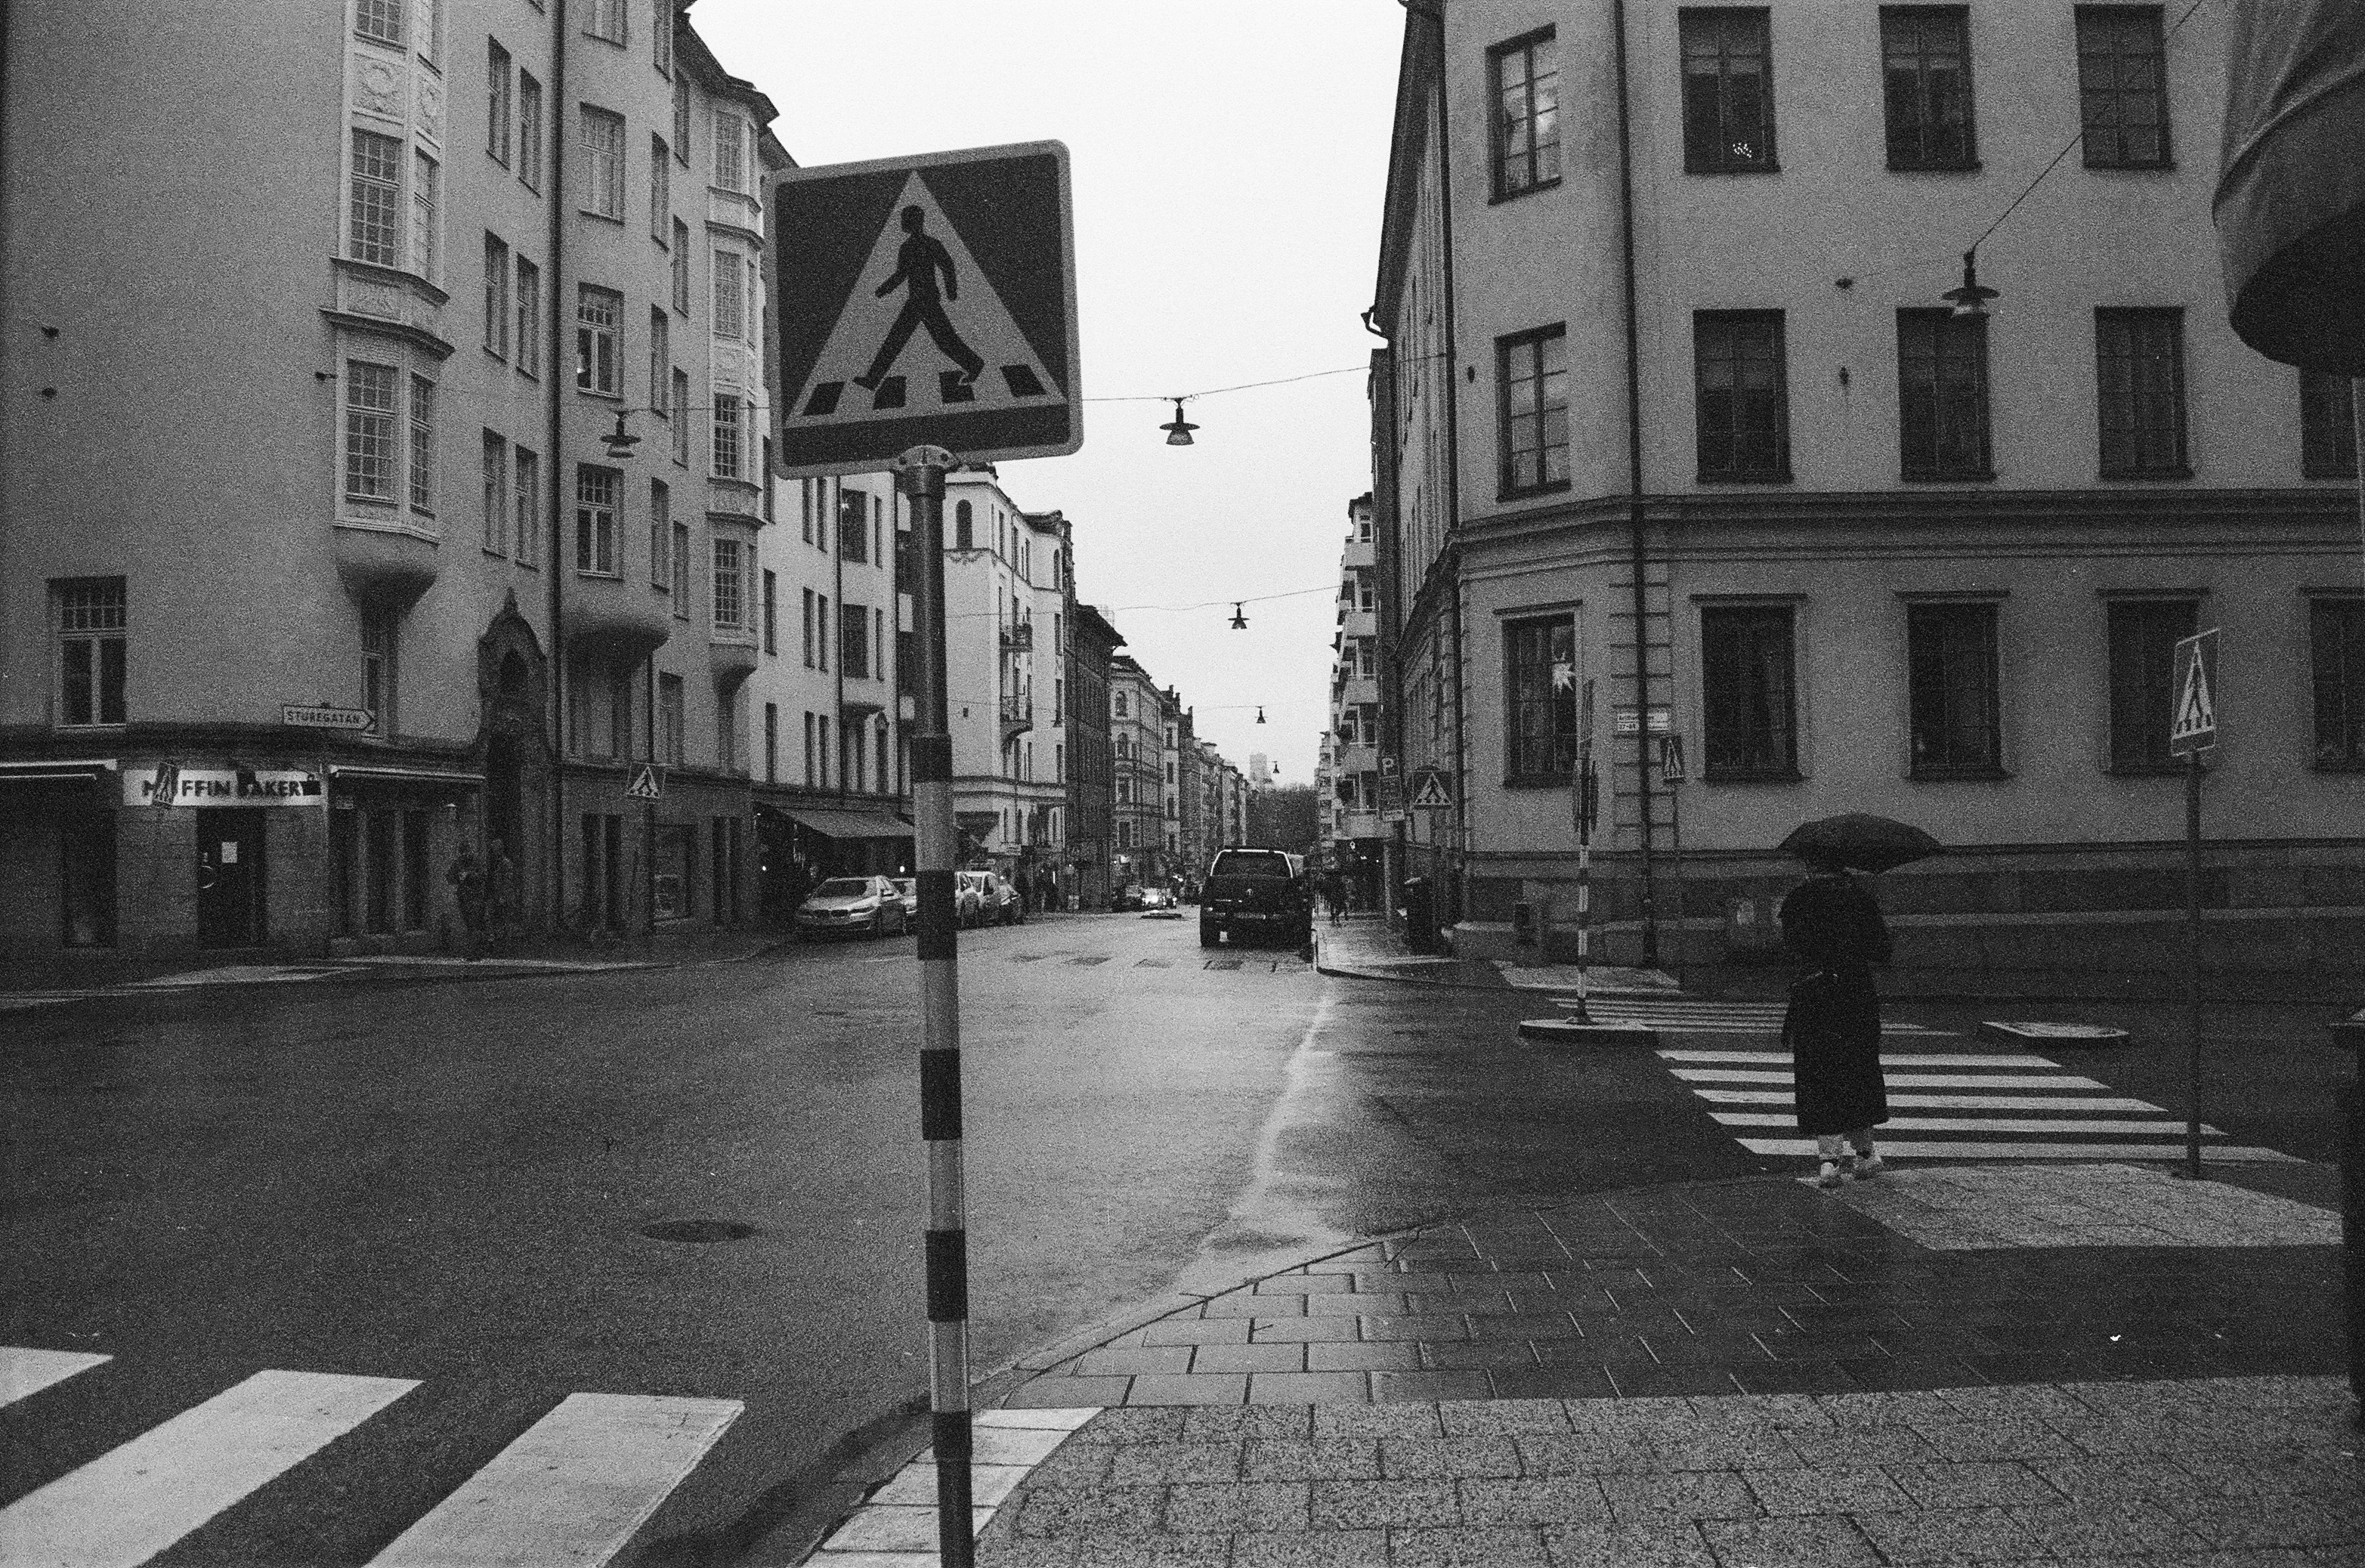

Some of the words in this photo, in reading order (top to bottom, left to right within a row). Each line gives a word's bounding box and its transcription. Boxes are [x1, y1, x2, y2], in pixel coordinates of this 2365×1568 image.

[286, 710, 360, 725] STUREGATAN
[1381, 757, 1394, 775] P
[142, 781, 230, 796] MFFIN
